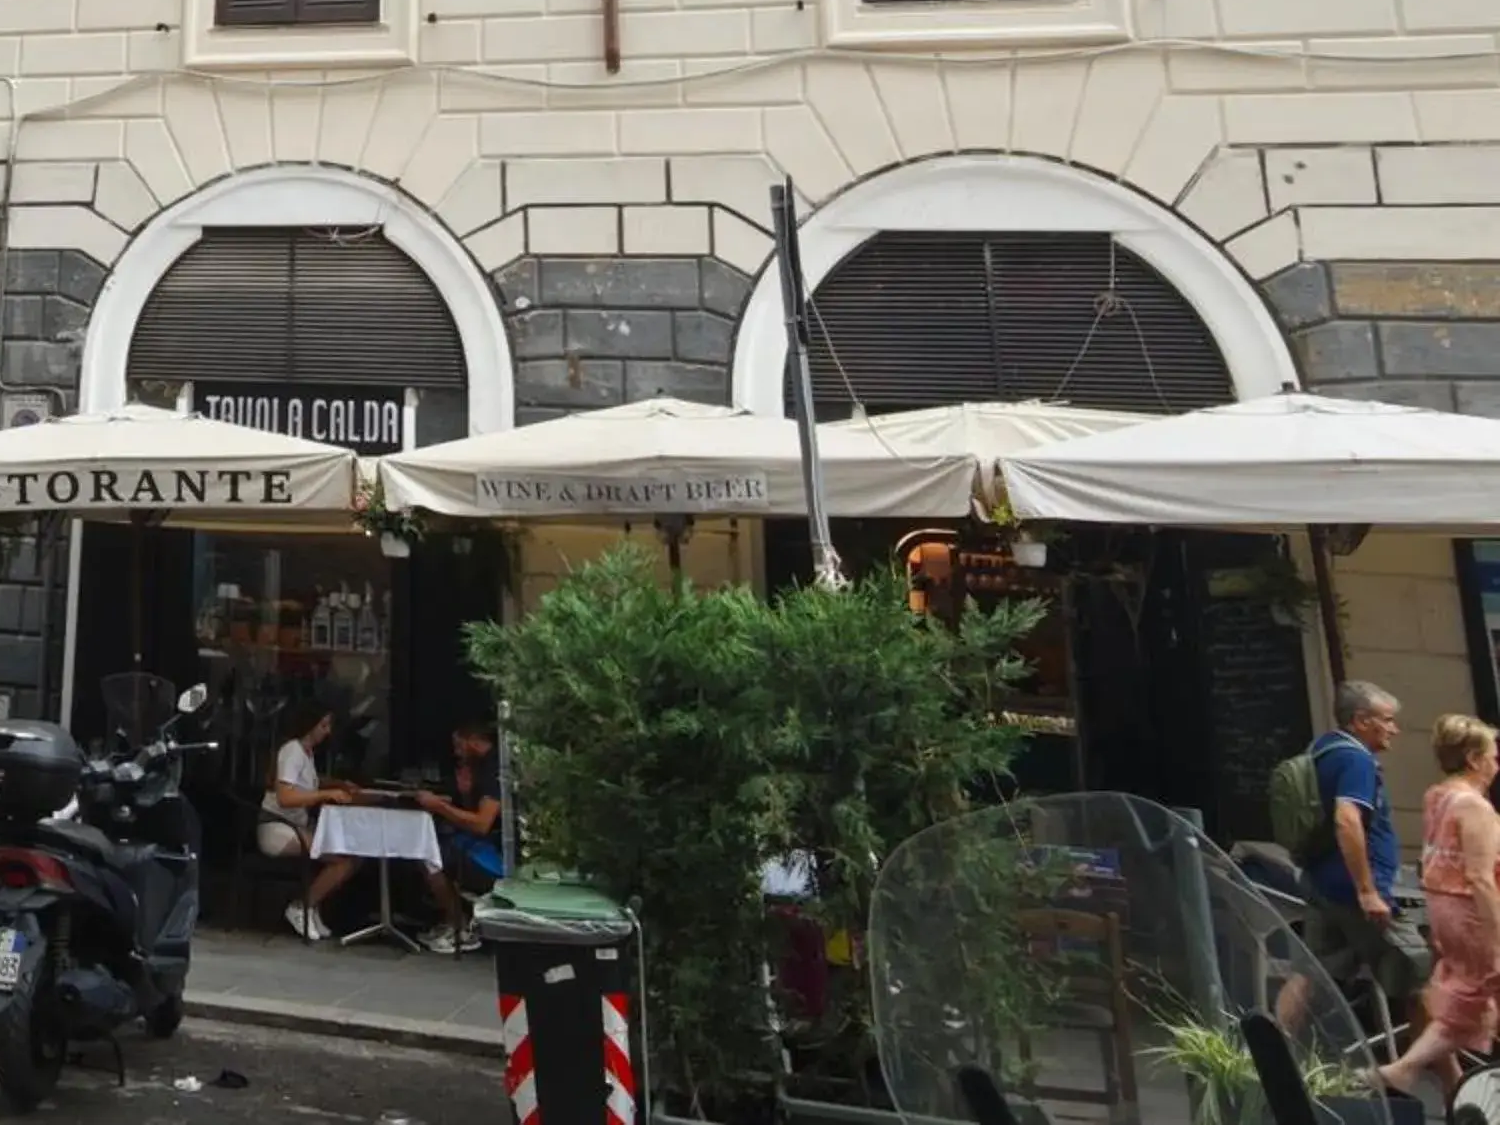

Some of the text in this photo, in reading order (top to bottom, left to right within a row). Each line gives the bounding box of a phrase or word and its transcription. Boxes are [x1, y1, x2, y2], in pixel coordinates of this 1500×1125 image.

[311, 398, 399, 443] CALDA
[481, 477, 764, 505] WINE & DRAFT BEER
